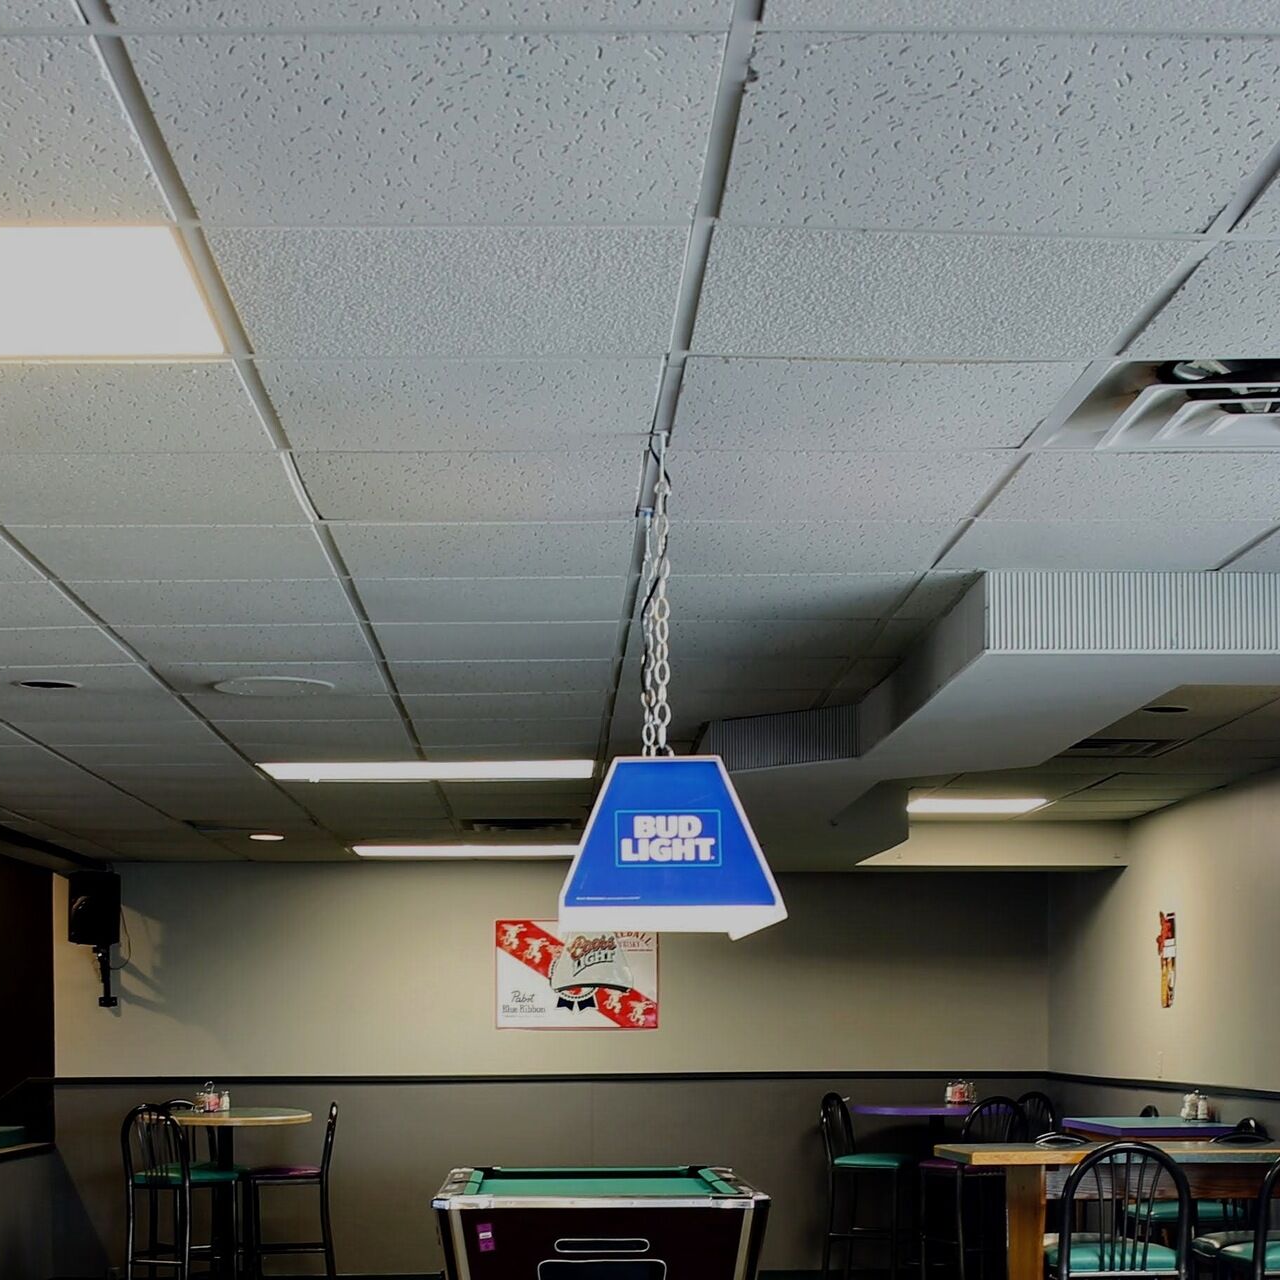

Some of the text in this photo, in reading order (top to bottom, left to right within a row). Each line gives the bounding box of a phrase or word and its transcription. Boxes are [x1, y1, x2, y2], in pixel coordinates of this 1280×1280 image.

[633, 815, 703, 839] BUD
[570, 935, 617, 960] Coors
[573, 949, 615, 972] LIGHT
[511, 990, 535, 1003] Pabst
[519, 1004, 546, 1013] Ribbon
